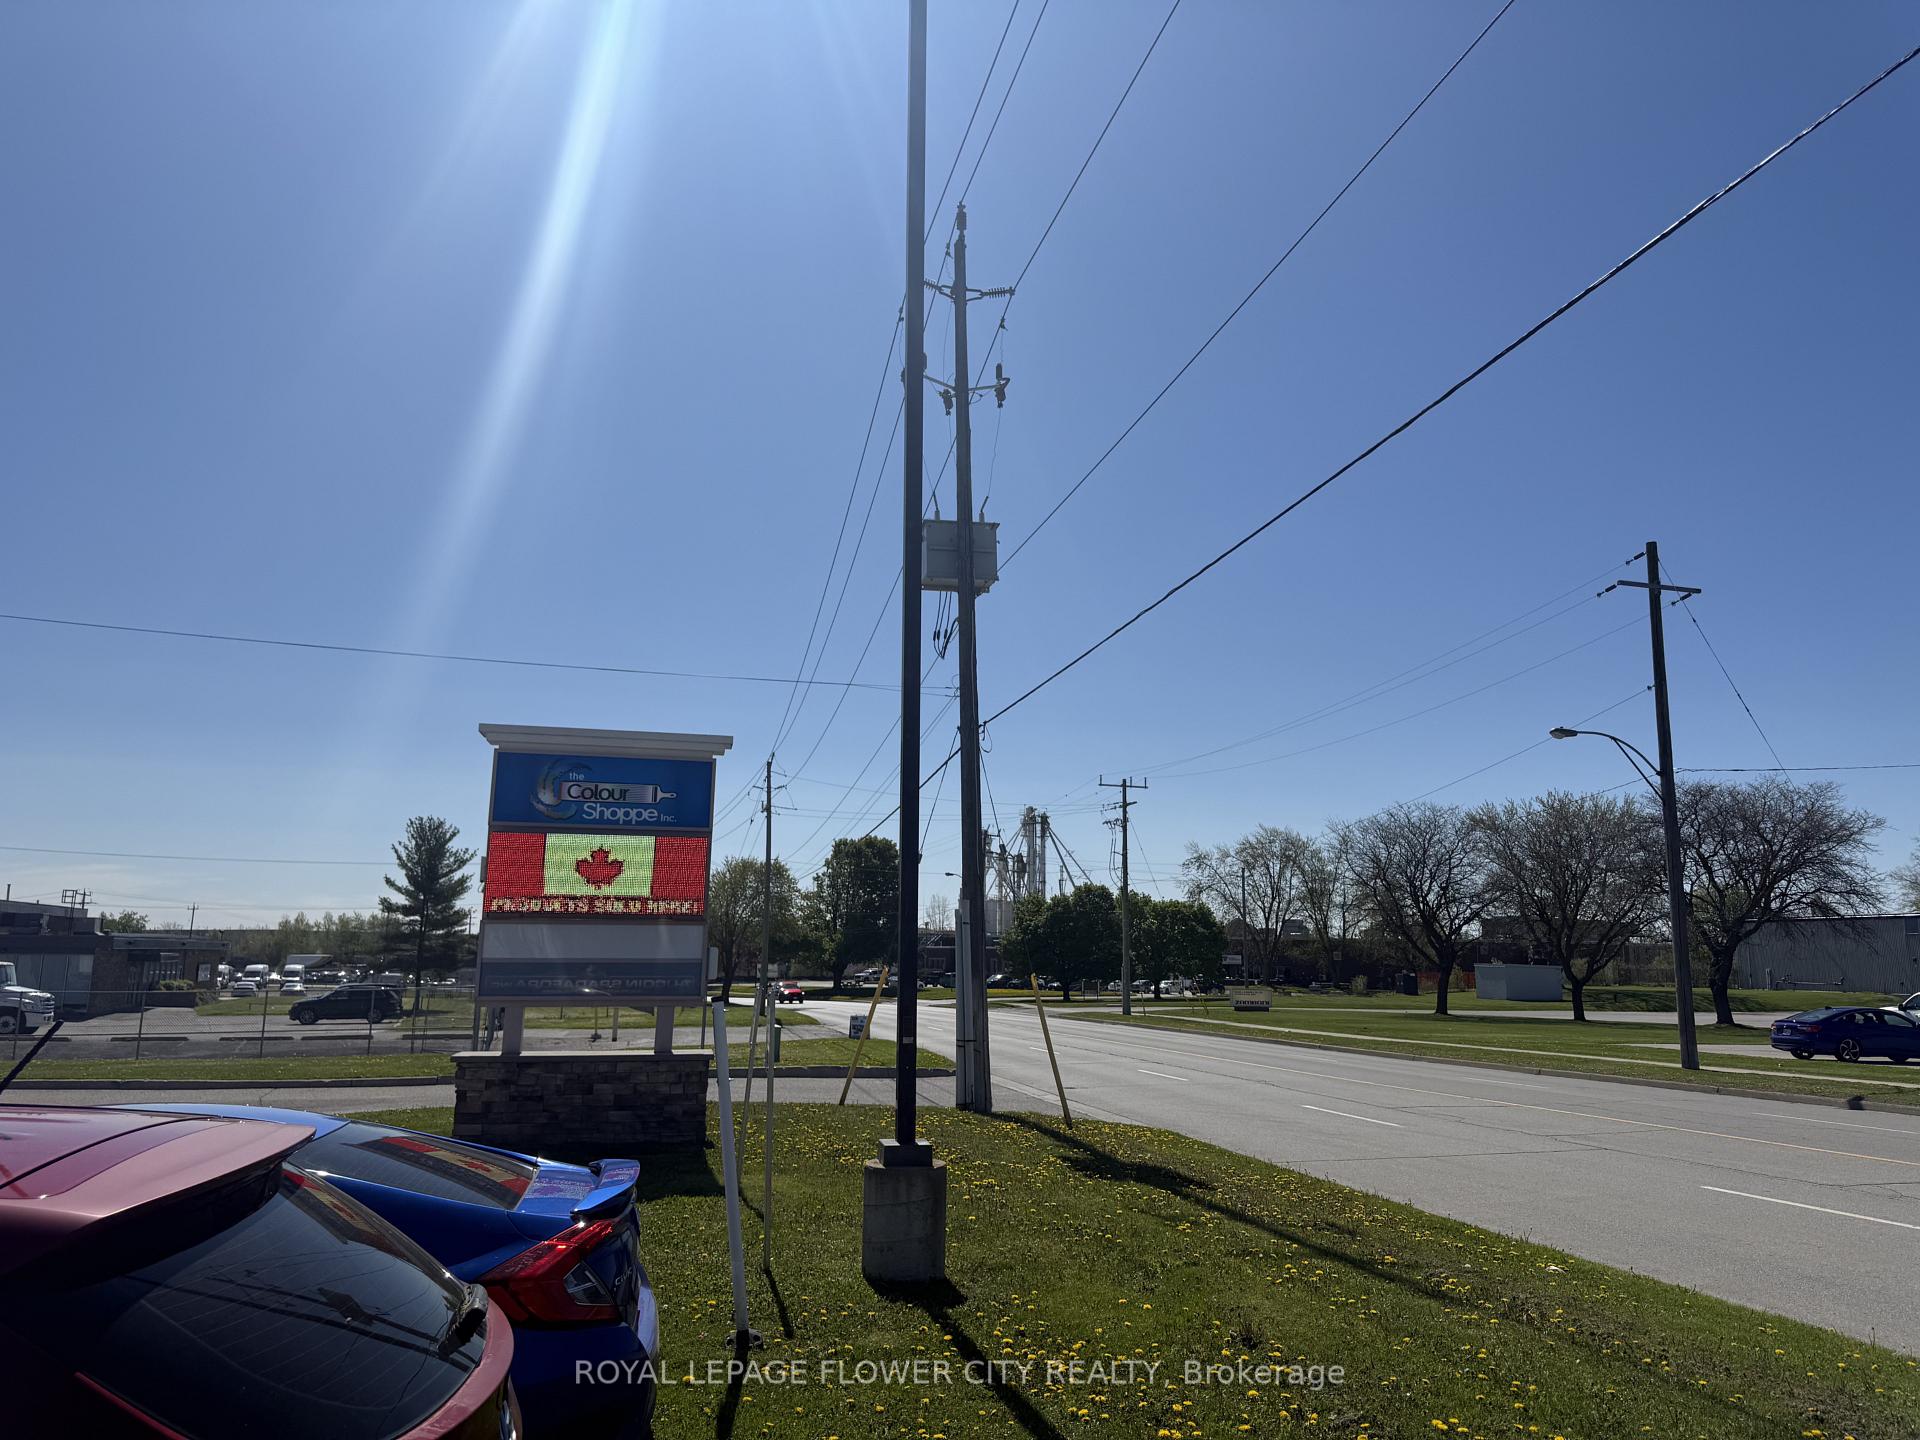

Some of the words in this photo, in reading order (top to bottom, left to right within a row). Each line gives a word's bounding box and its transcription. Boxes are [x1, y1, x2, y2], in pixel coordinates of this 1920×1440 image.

[569, 772, 585, 781] the
[567, 783, 630, 801] Colour
[582, 803, 658, 824] Shoppe
[660, 814, 677, 823] Inc.
